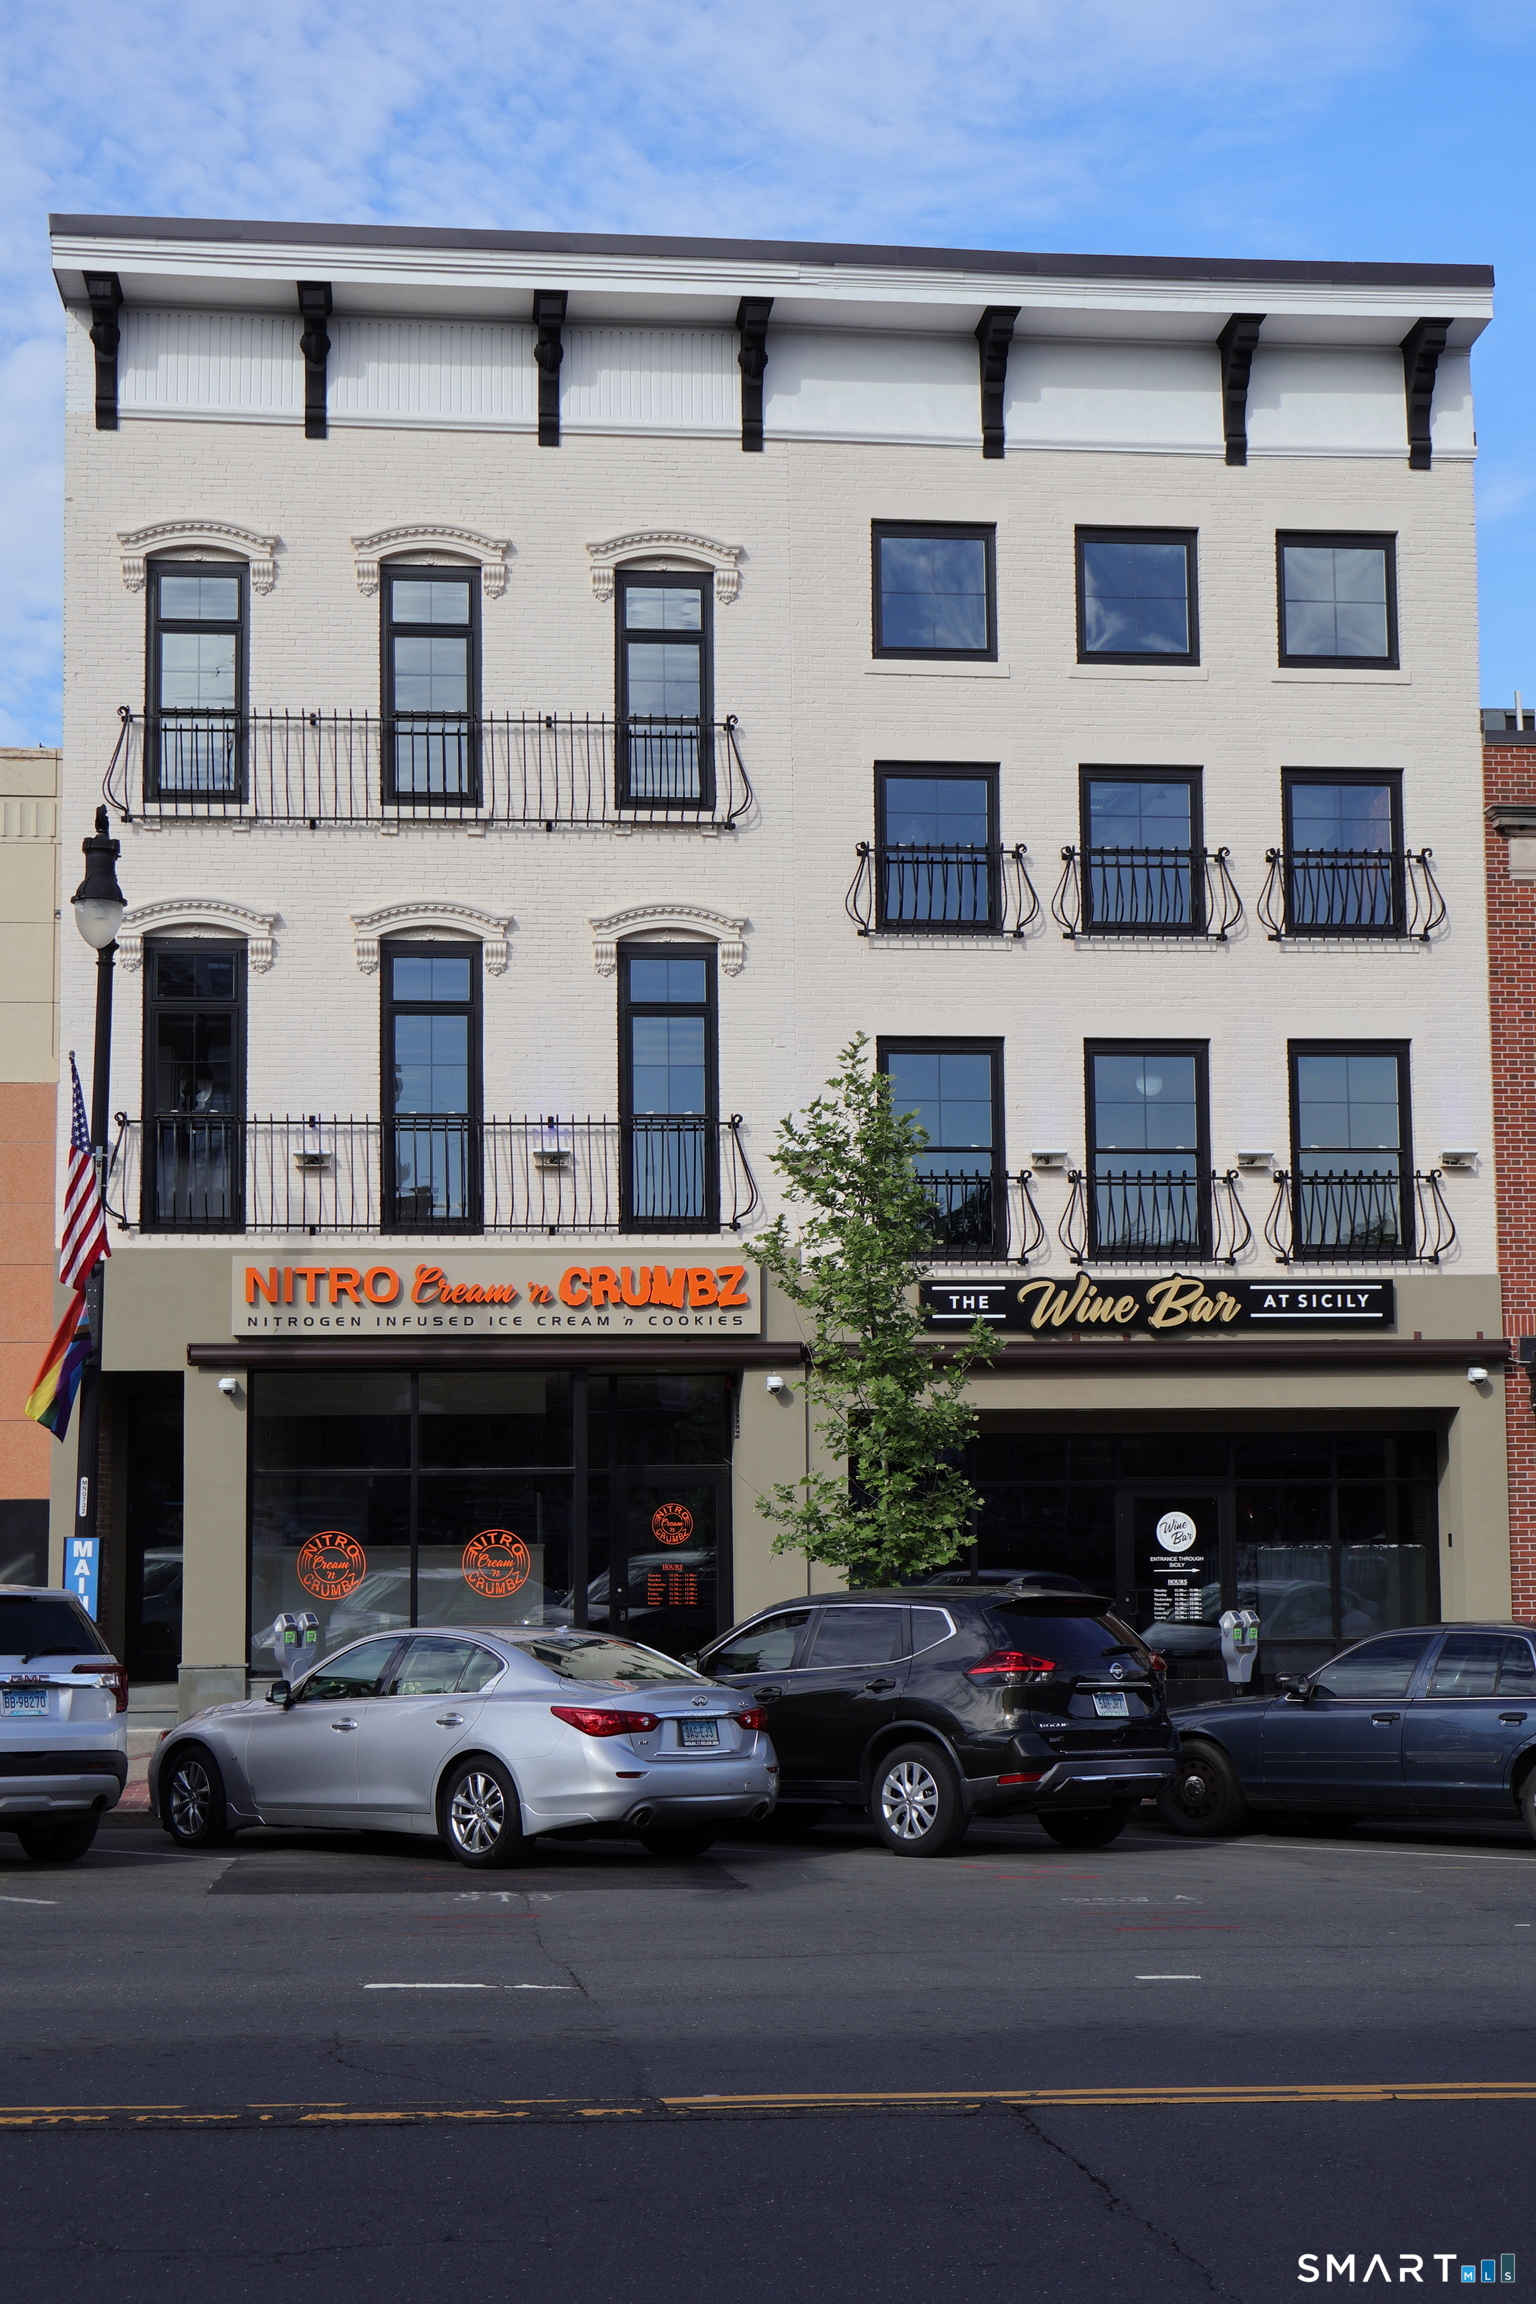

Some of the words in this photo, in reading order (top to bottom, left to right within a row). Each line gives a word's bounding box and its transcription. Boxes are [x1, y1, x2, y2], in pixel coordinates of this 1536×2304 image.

[245, 1266, 400, 1304] NITRO
[411, 1264, 518, 1304] Cream
[559, 1265, 749, 1309] CRUMBZ
[949, 1295, 989, 1309] THE
[1017, 1274, 1140, 1330] Wine
[1146, 1276, 1242, 1329] Bar
[1263, 1294, 1290, 1308] AT
[1297, 1294, 1370, 1308] SICILY
[247, 1316, 361, 1327] NITROGEN
[376, 1316, 474, 1326] INFUSED
[489, 1316, 522, 1326] ICE
[537, 1316, 610, 1326] CREAM
[648, 1315, 744, 1326] COOKIES
[656, 1505, 690, 1520] NITRO
[1159, 1519, 1188, 1534] Wine
[655, 1528, 690, 1543] CRUMBZ
[1170, 1531, 1193, 1545] Bar
[303, 1534, 359, 1558] NITRO
[469, 1532, 524, 1556] NITRO
[312, 1555, 350, 1570] Cream
[477, 1553, 515, 1568] Cream
[303, 1572, 361, 1597] CRUMBZ
[468, 1571, 524, 1595] CRUMBZ
[9, 1674, 50, 1683] GMC
